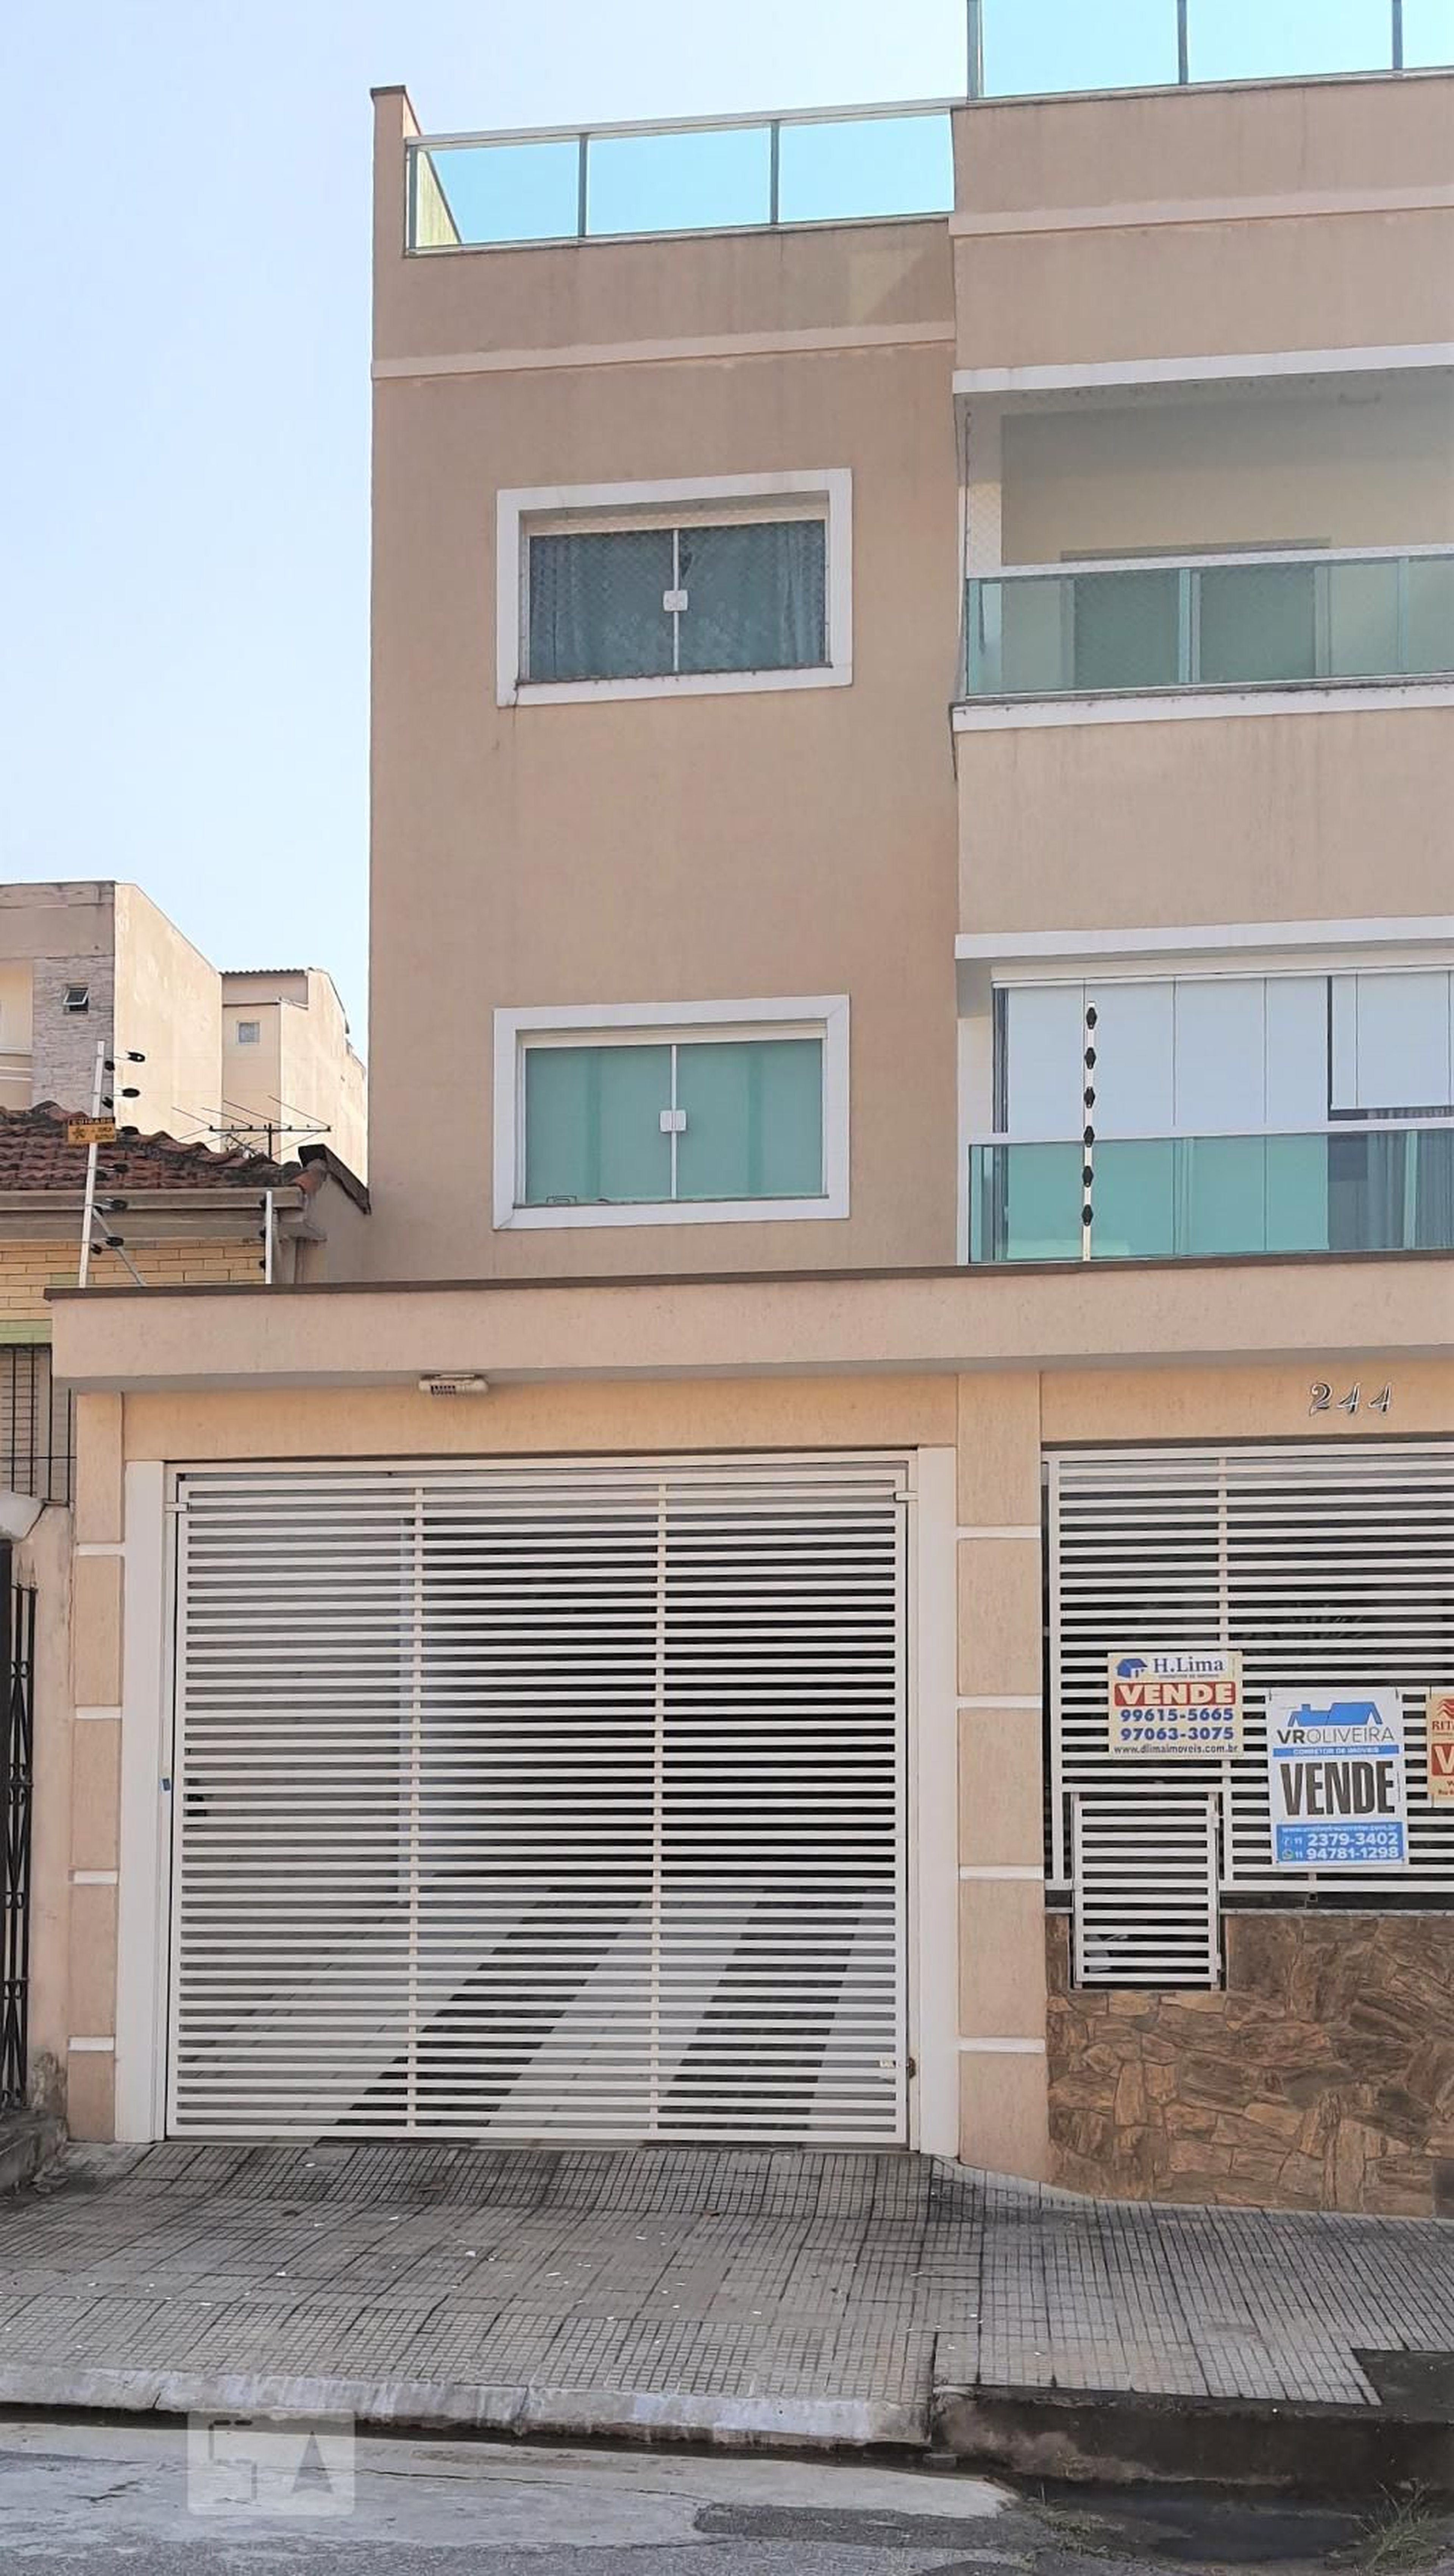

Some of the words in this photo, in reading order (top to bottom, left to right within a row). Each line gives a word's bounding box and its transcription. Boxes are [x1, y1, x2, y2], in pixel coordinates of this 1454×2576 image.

[1309, 1381, 1392, 1416] 244
[1153, 1657, 1225, 1673] H.Lima
[1118, 1684, 1232, 1704] VENDE
[1121, 1708, 1233, 1722] 99615-5665
[1121, 1727, 1234, 1740] 97063-3075
[1280, 1761, 1395, 1815] VENDE
[1308, 1832, 1398, 1846] 2379-3402
[1306, 1847, 1399, 1860] 94781-1298
